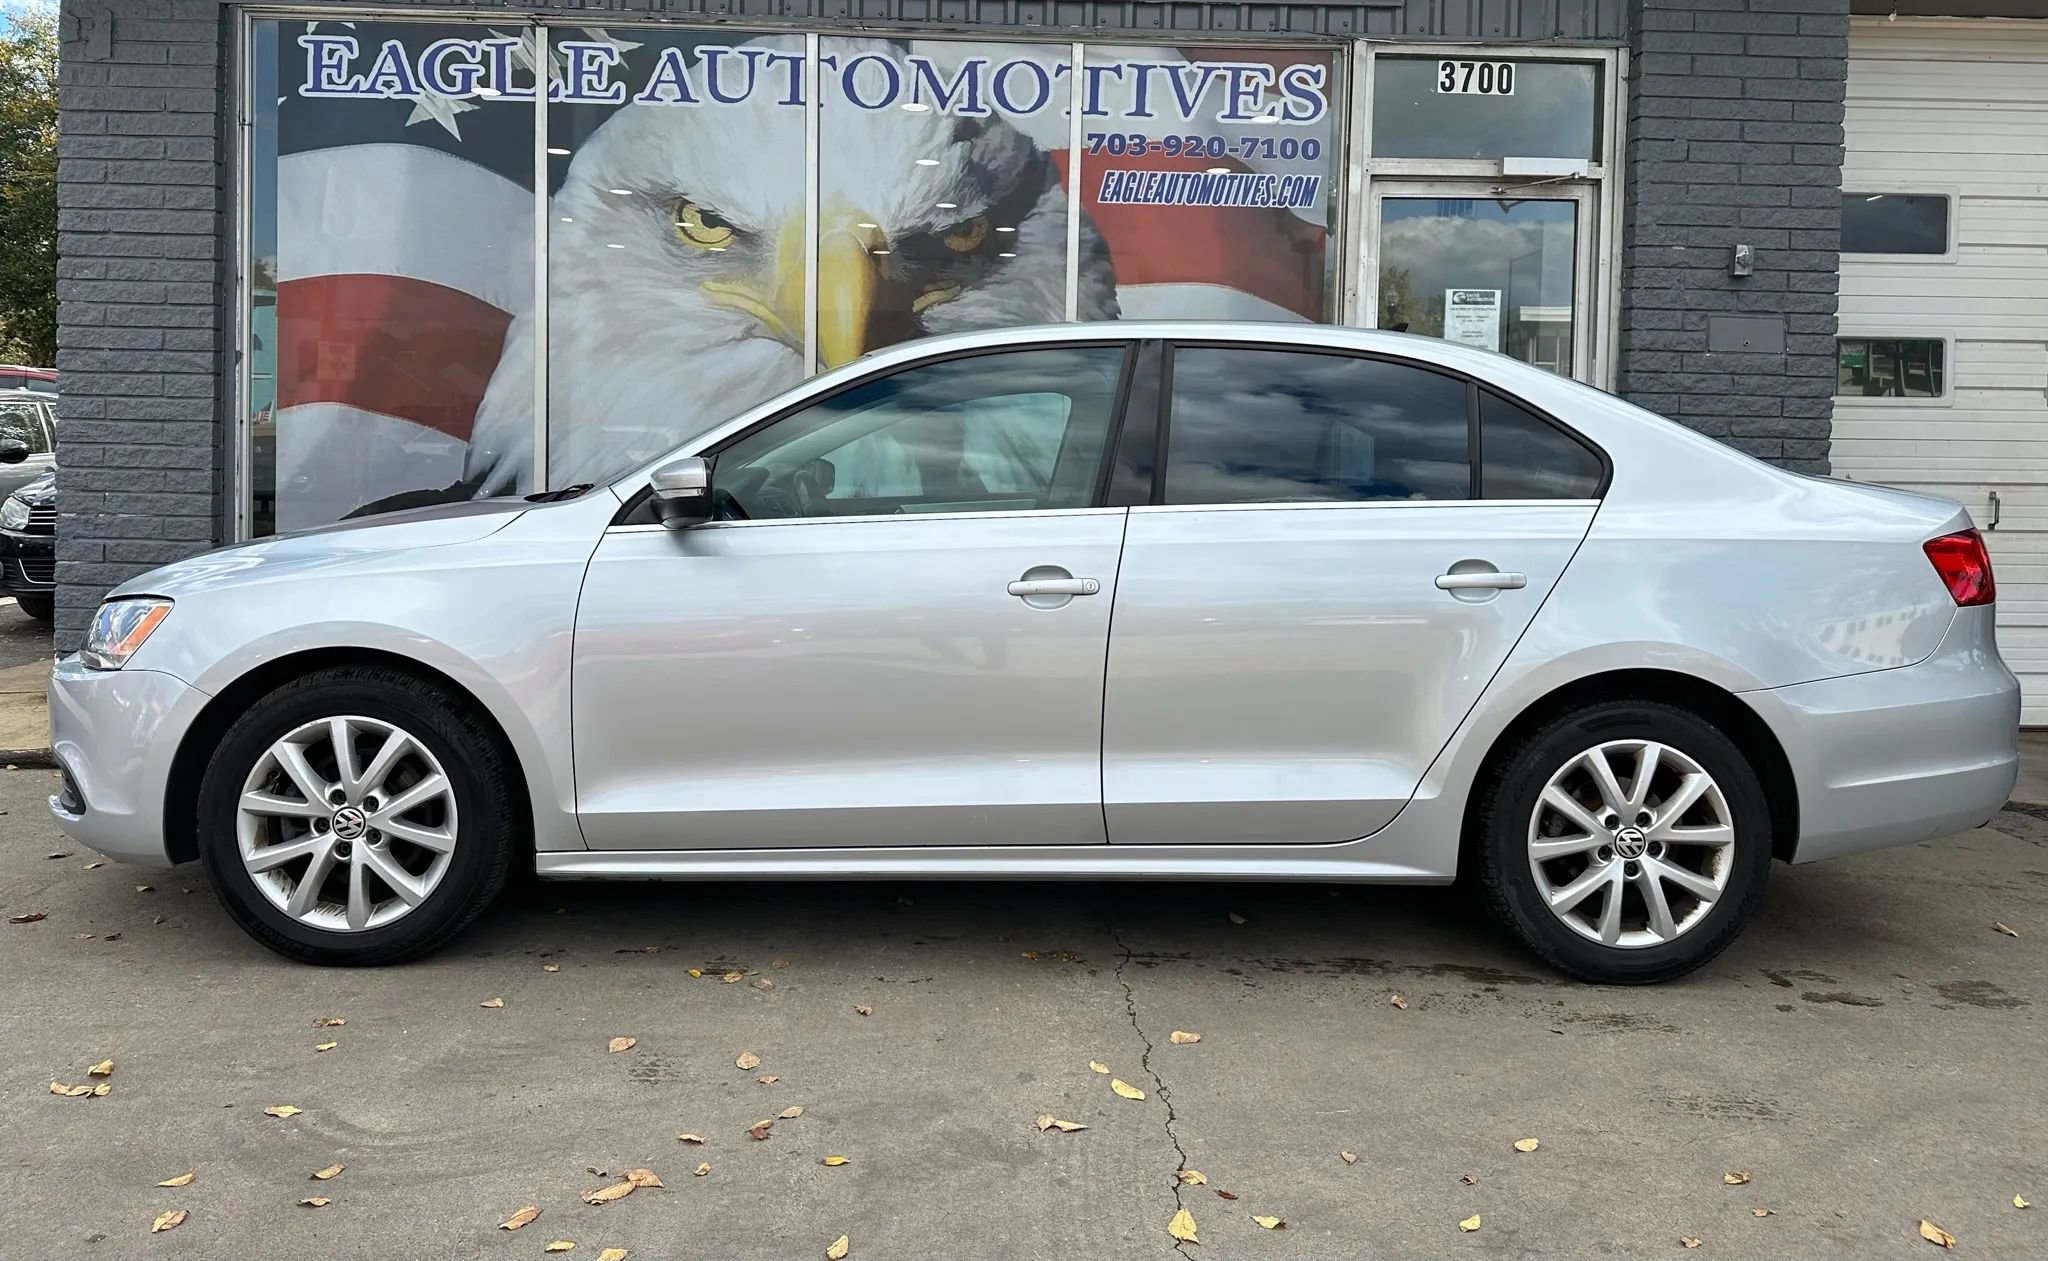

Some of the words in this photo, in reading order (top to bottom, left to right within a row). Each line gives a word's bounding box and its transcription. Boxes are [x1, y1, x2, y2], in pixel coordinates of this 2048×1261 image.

[300, 36, 624, 103] EAGLE
[635, 46, 1325, 123] AUTOMOTIVES
[1440, 61, 1513, 94] 3700
[1087, 132, 1321, 161] 703-920-7100
[1099, 170, 1321, 208] EAGLEAUTOMOTIVES.COM
